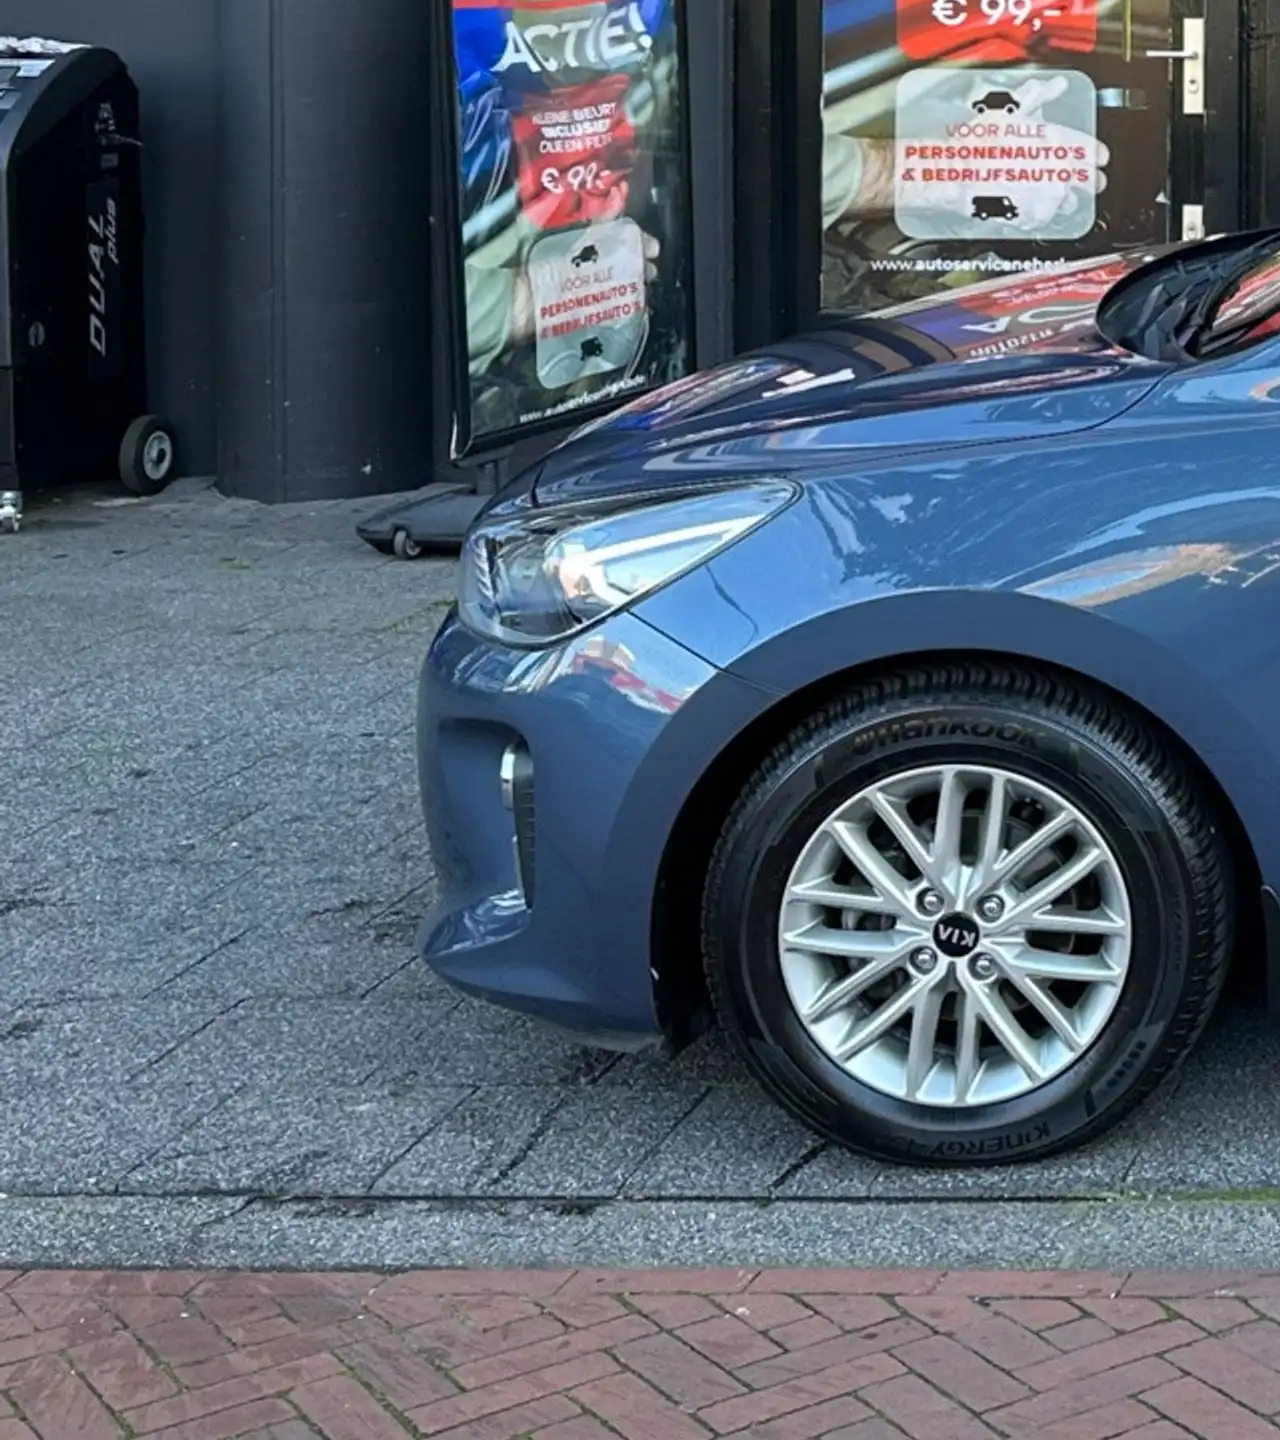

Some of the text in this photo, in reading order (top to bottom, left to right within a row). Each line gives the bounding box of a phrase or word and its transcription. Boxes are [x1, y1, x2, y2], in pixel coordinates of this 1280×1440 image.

[490, 3, 653, 73] ACTIE!
[943, 124, 1046, 137] VOOR ALLE
[905, 146, 1086, 160] PERSONENAUTO'S
[902, 168, 1089, 182] & BEDRIJFSAUTO'S
[88, 214, 106, 357] DUAL
[938, 923, 976, 947] KIA
